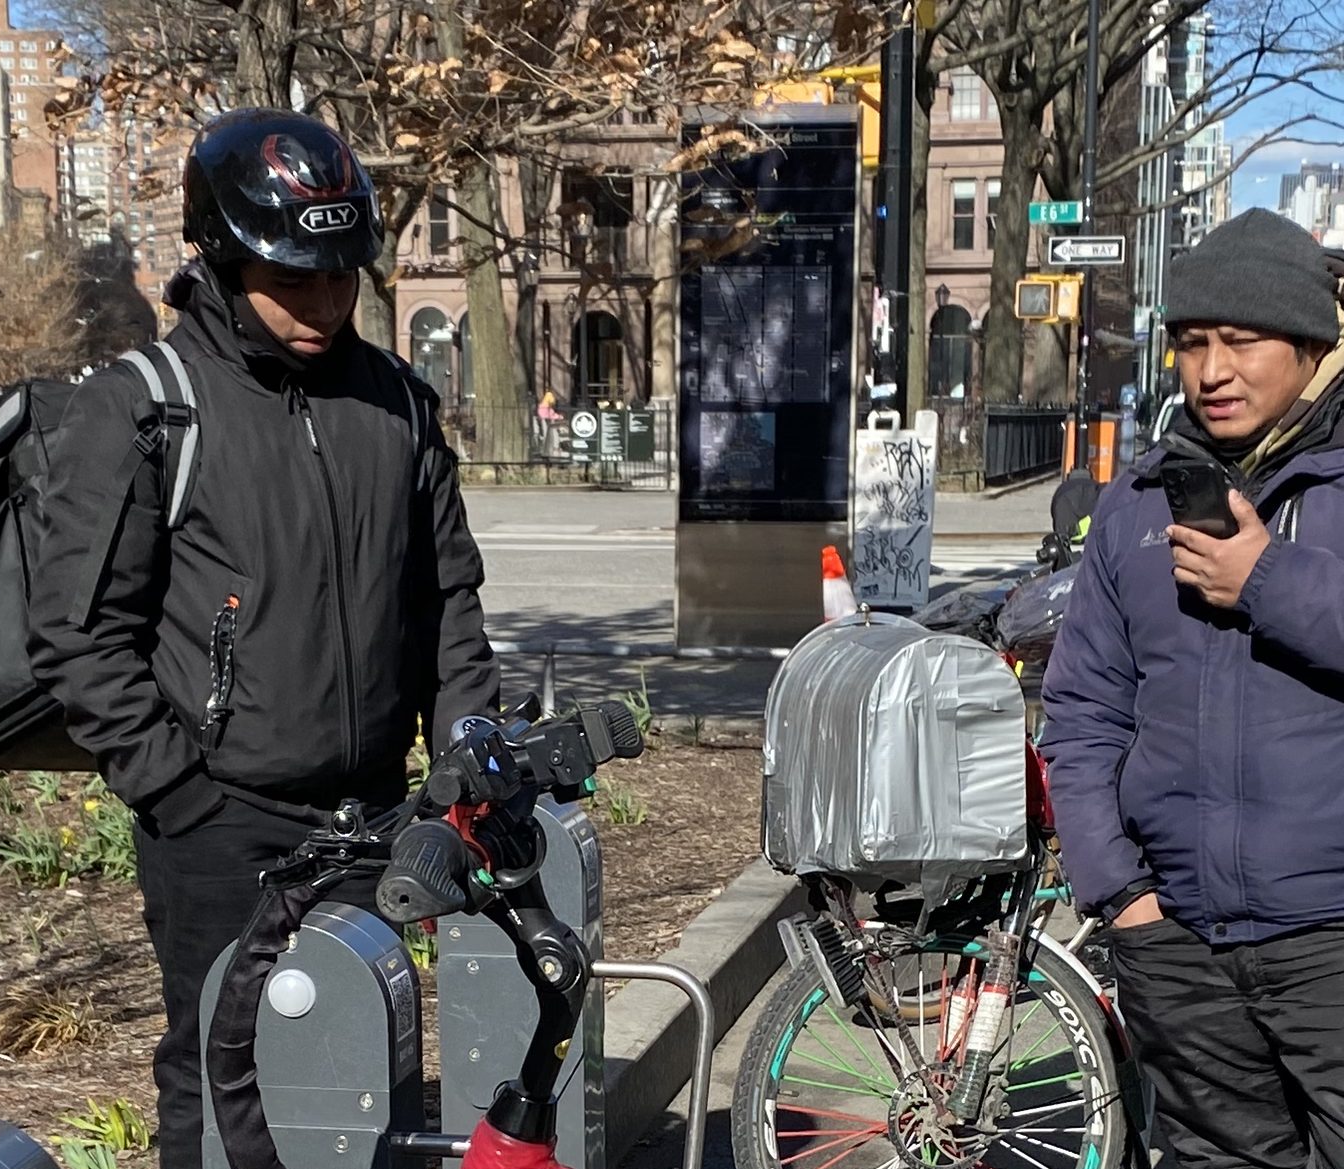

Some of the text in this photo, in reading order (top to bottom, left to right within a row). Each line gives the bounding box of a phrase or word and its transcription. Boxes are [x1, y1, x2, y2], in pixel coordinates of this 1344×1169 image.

[309, 208, 350, 228] FLY
[1040, 206, 1047, 221] E
[1049, 206, 1058, 220] 6
[1061, 244, 1114, 255] ONE WAY
[1042, 988, 1099, 1070] 90XC
